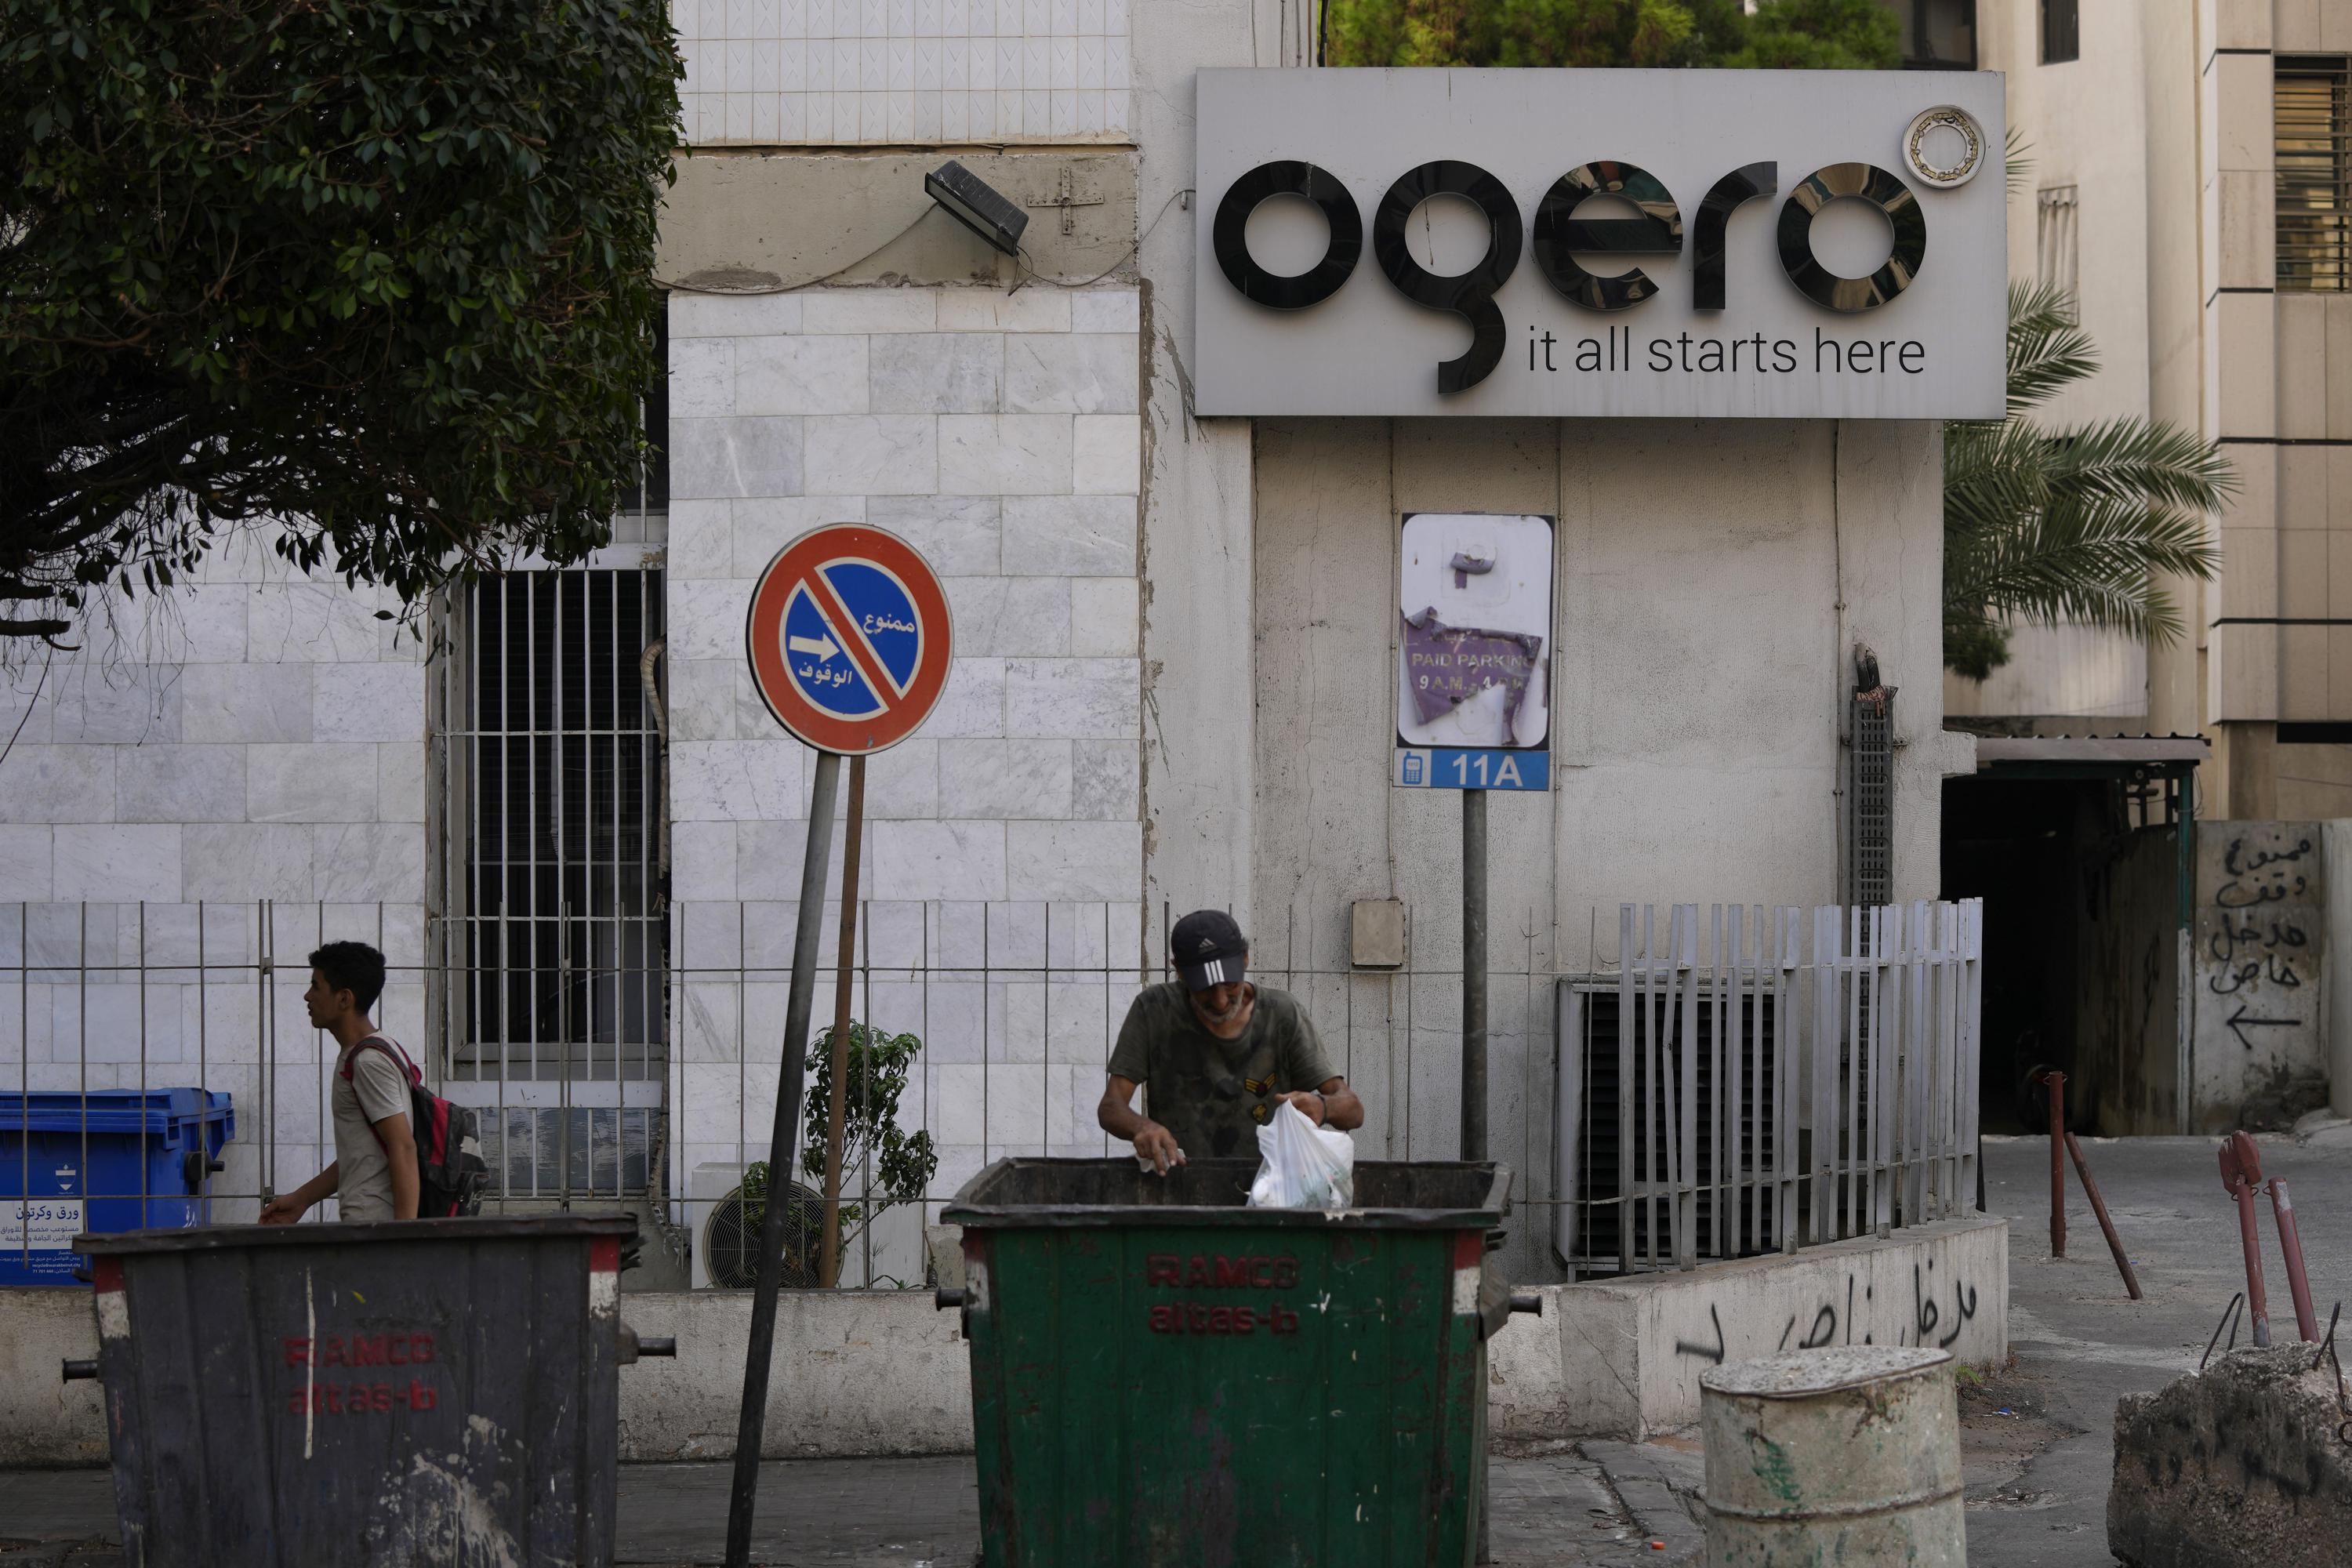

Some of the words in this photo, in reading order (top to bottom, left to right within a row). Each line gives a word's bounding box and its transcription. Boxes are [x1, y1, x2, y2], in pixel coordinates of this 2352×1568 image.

[1213, 159, 1926, 395] ogero
[1530, 327, 1557, 373] it
[1575, 326, 1630, 373] all
[1647, 331, 1797, 373] starts
[1815, 328, 1926, 374] here
[863, 613, 915, 633] ممنوع
[799, 662, 852, 688] الوقوف
[1412, 653, 1452, 666] PAID
[1420, 675, 1429, 689] 9
[1452, 753, 1523, 786] 11A
[2225, 835, 2311, 876] ممنوع
[2211, 913, 2307, 960] مدخل
[2210, 954, 2301, 993] خاص
[16, 1206, 52, 1220] وكرتون
[57, 1207, 78, 1219] ورق
[1146, 1254, 1299, 1287] RAMCO
[283, 1334, 434, 1368] RAMCO
